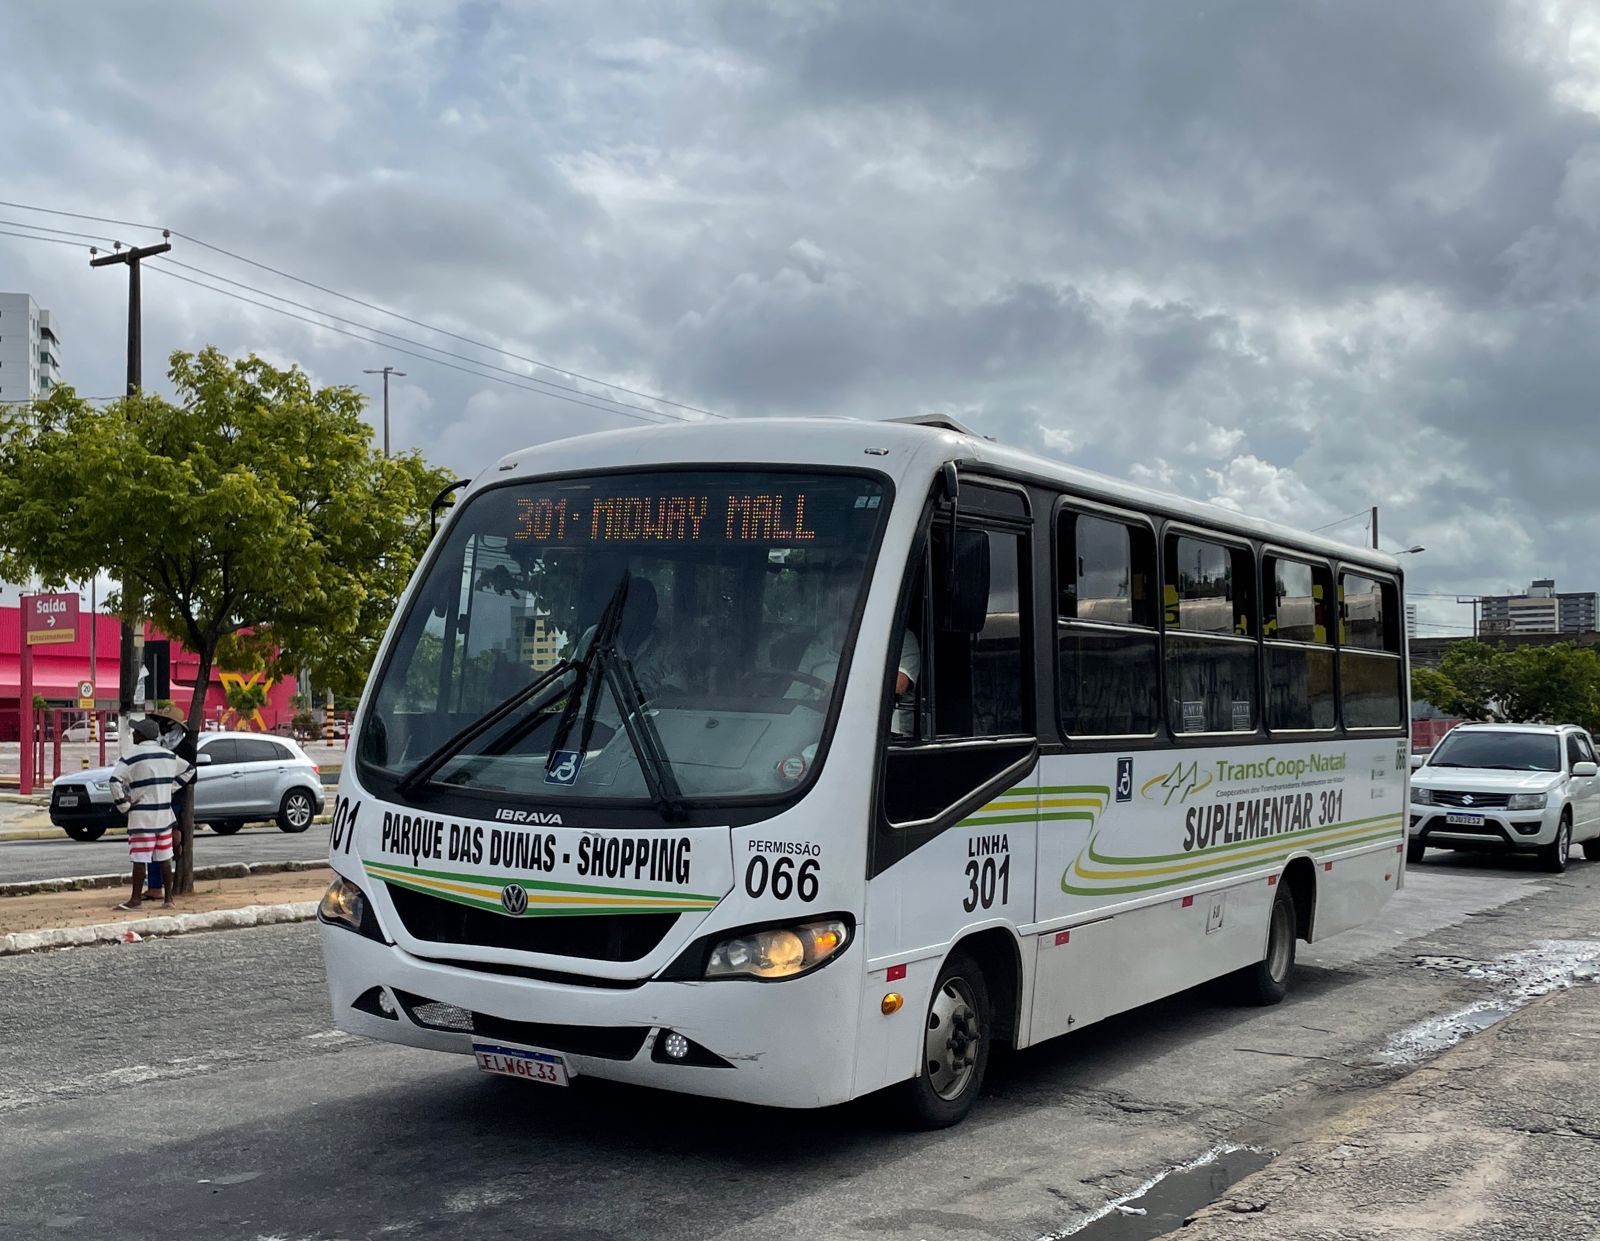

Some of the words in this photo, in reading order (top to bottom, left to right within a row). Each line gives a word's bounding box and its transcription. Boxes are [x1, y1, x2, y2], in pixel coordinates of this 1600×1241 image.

[591, 496, 707, 540] MIDWAY
[726, 494, 815, 540] MALL
[1216, 752, 1347, 782] TransCoop-Natal
[495, 808, 563, 825] IBRAVA
[1183, 792, 1314, 852] SUPLEMENTAR
[1319, 788, 1344, 826] 301
[381, 811, 444, 867] PARQUE
[448, 824, 484, 865] DAS
[489, 829, 556, 873] DUNAS
[577, 836, 691, 885] SHOPPING
[748, 839, 821, 857] PERMISSÃO
[968, 833, 1009, 858] LINHA
[745, 854, 821, 903] 066
[962, 854, 1010, 913] 301
[482, 1053, 557, 1082] ELW6E33
